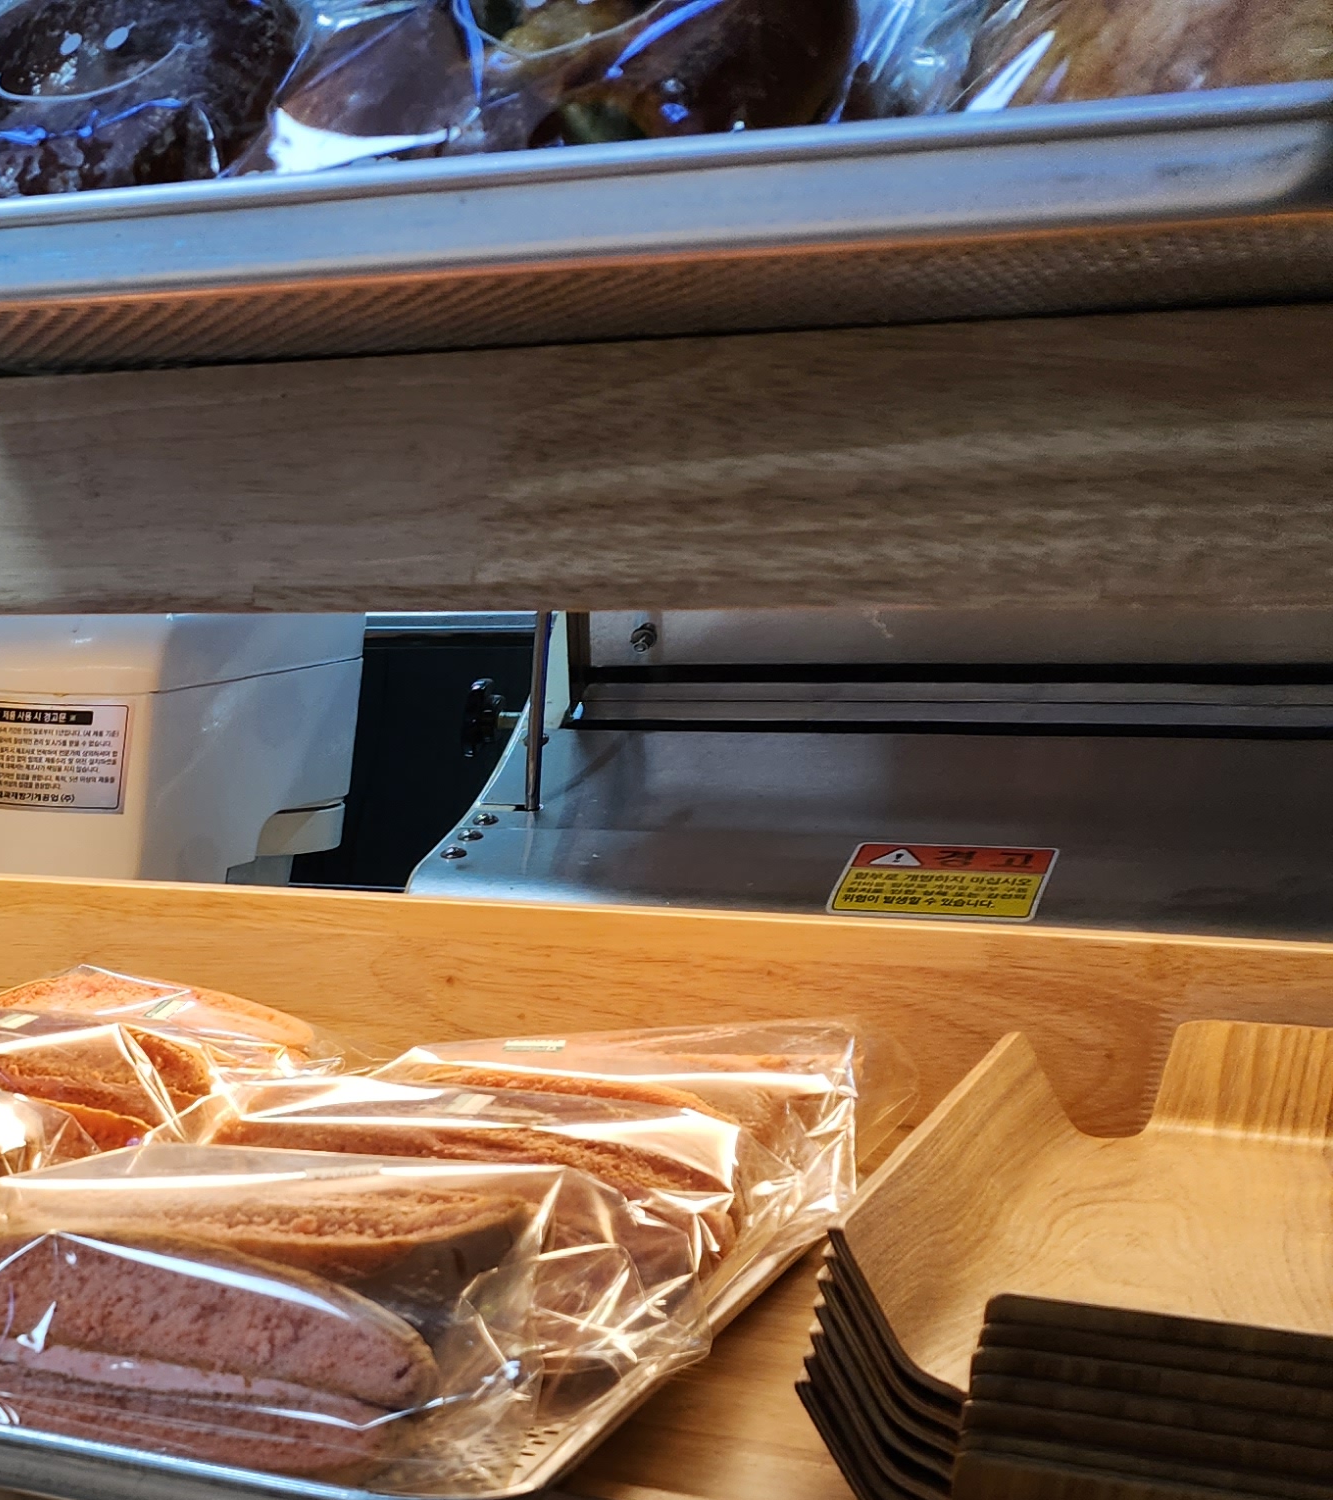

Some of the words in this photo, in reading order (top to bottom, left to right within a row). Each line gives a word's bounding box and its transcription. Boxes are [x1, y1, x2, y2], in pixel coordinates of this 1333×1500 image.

[904, 873, 966, 884] 개방하지
[971, 875, 1032, 886] 마십시오
[843, 894, 879, 904] 위험이
[883, 895, 921, 905] 발생할
[941, 897, 995, 909] 있습니다.
